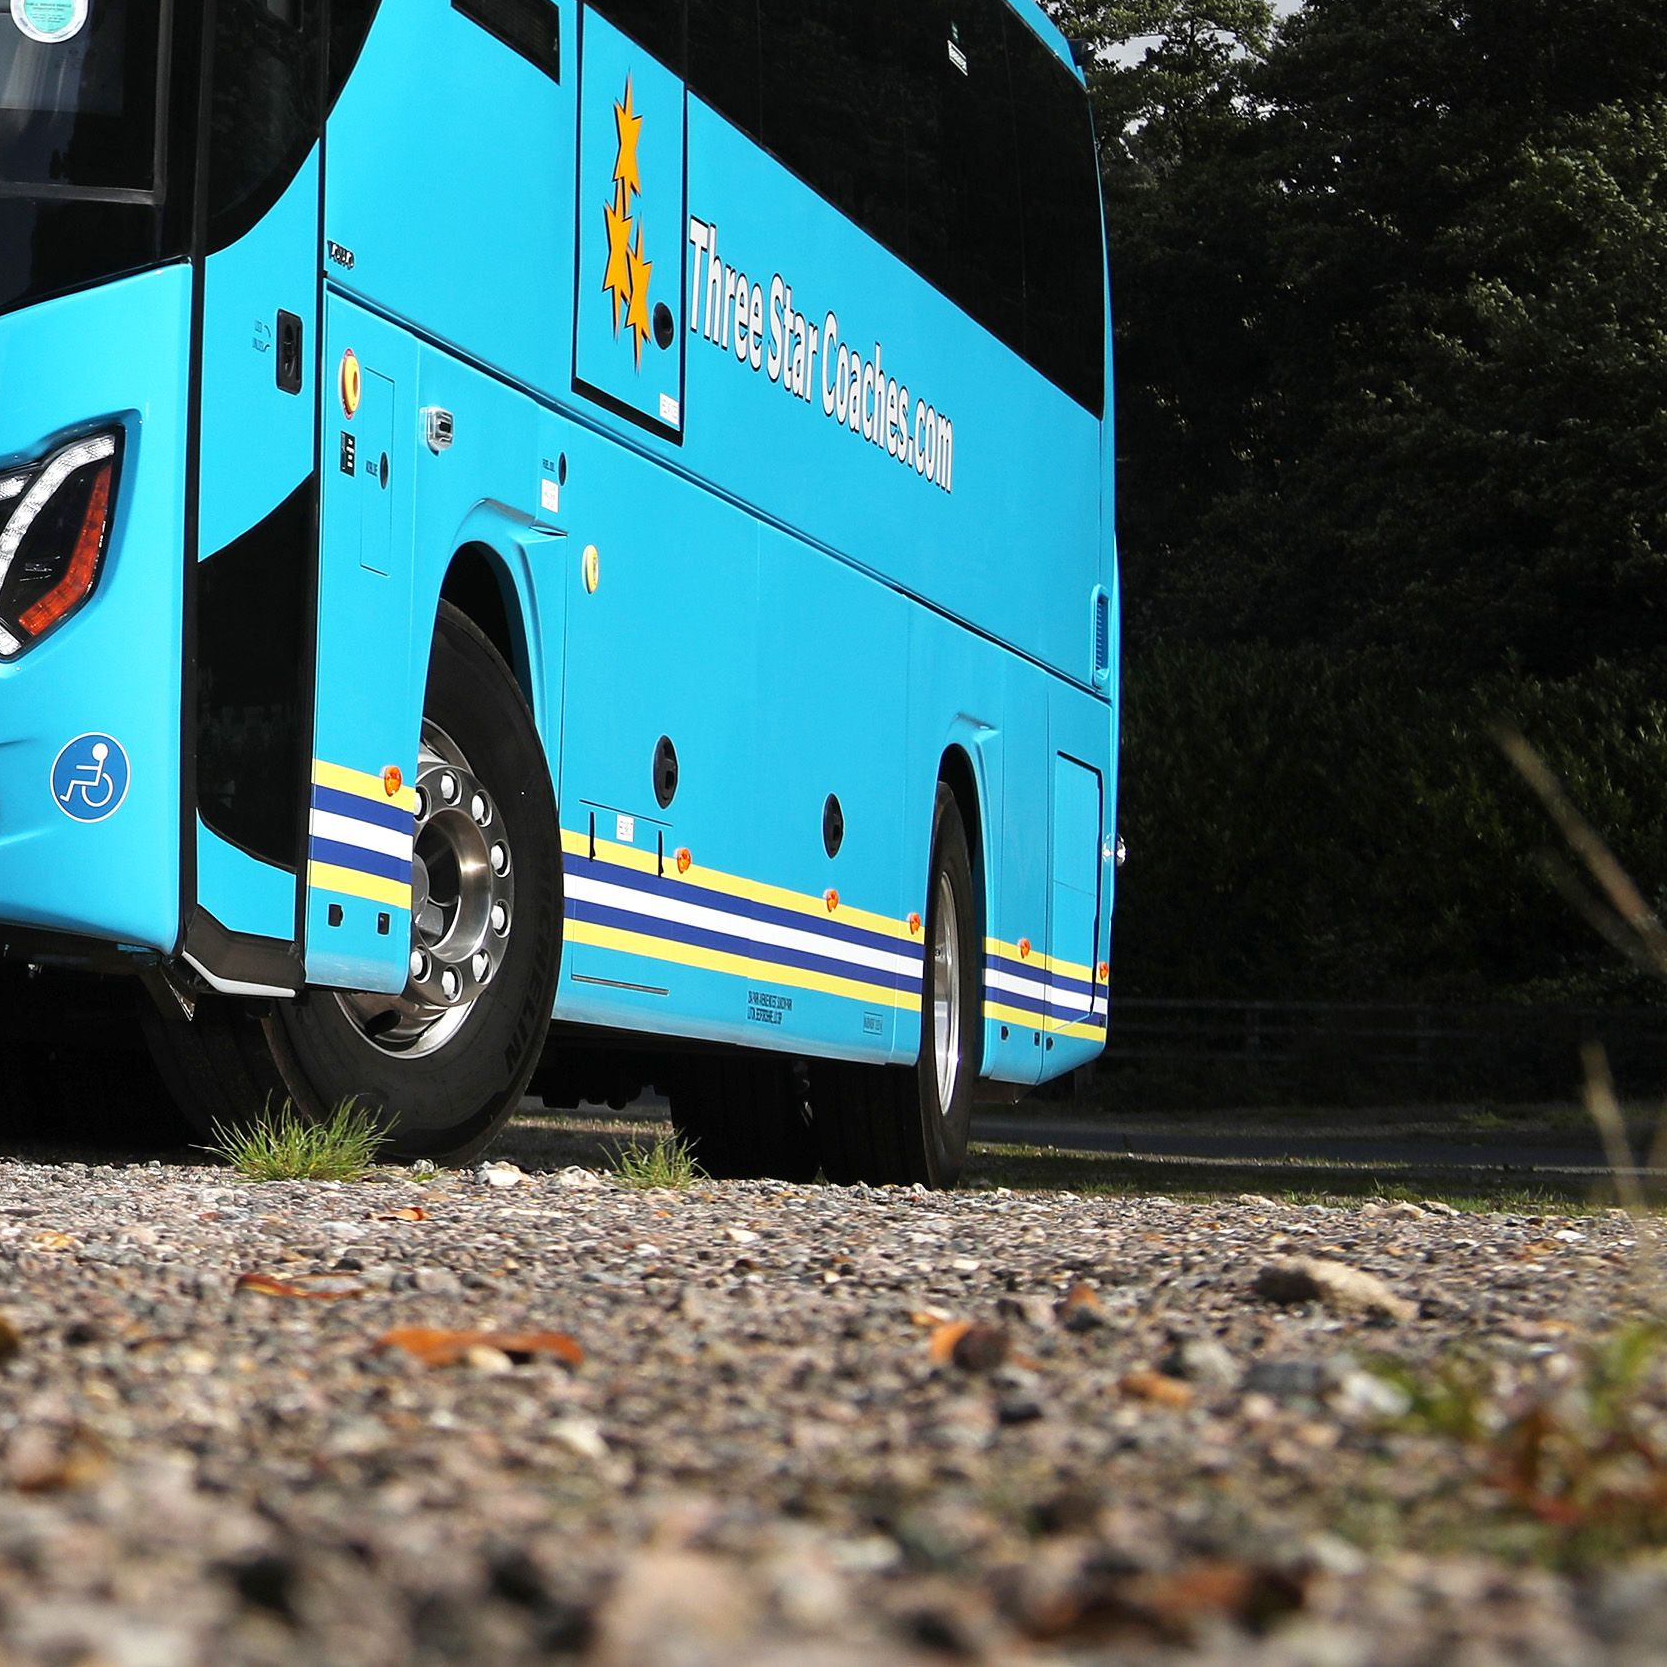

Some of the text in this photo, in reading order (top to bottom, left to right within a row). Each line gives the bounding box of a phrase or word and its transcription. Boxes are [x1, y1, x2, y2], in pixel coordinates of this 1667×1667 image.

[689, 214, 953, 494] Three Star Coaches.com
